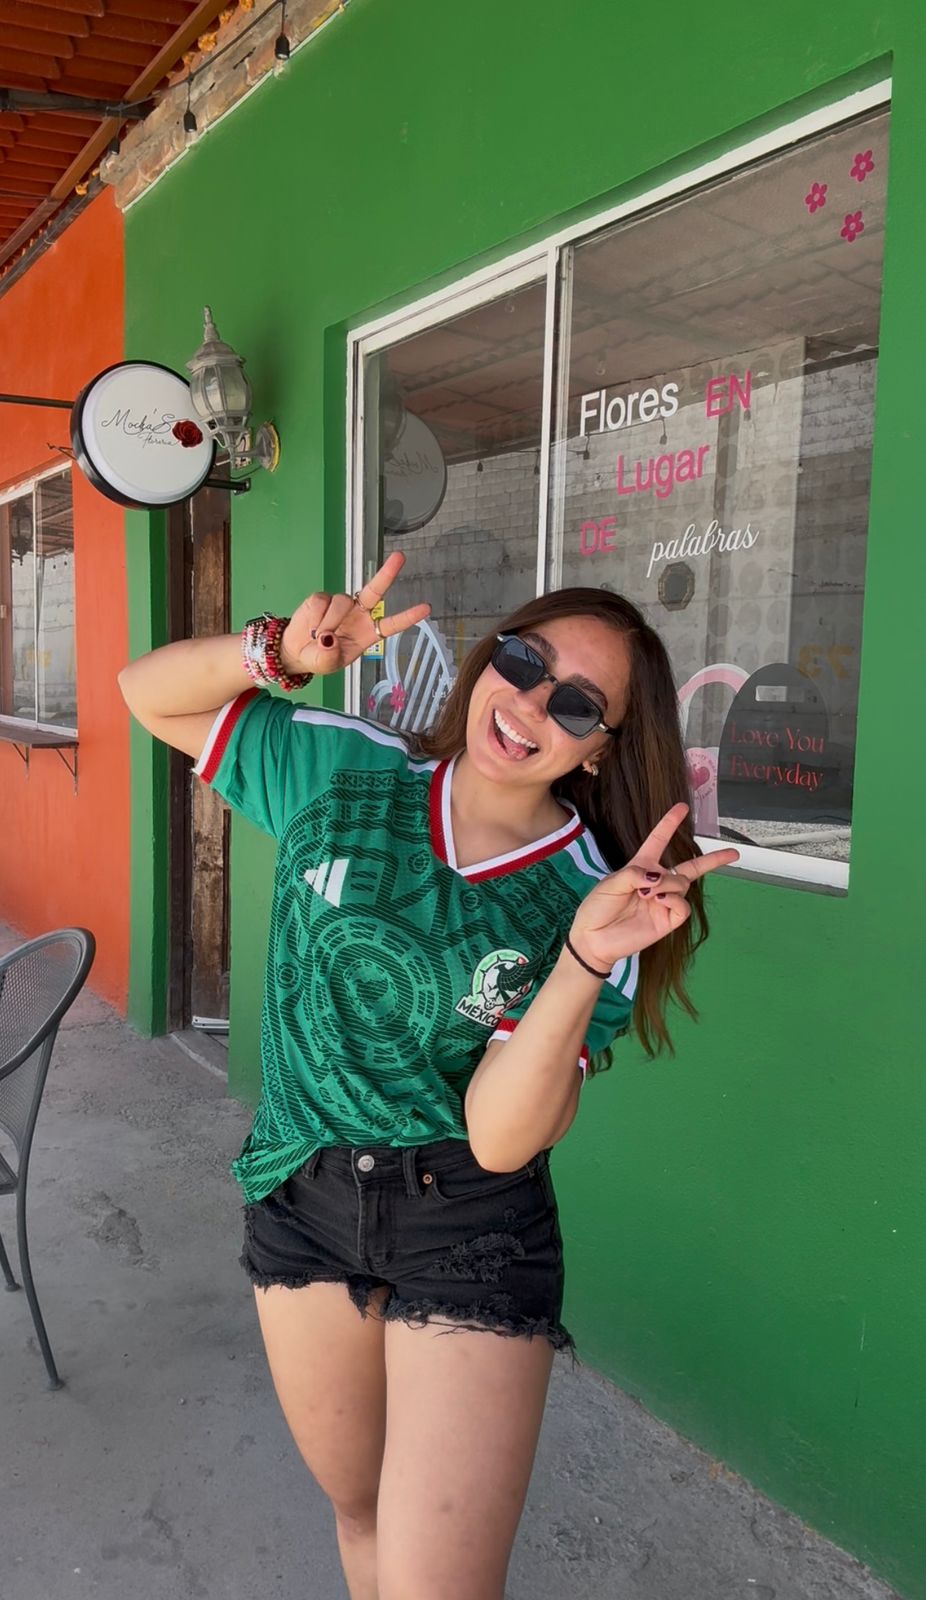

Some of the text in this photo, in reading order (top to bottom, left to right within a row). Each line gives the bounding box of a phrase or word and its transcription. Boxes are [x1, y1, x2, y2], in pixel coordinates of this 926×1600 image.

[580, 370, 752, 436] Flores EN
[616, 444, 711, 500] Lugar
[579, 515, 760, 578] DE palabras
[730, 720, 825, 754] Love You
[730, 754, 824, 792] Everyday
[458, 1000, 500, 1026] MÉXICO
